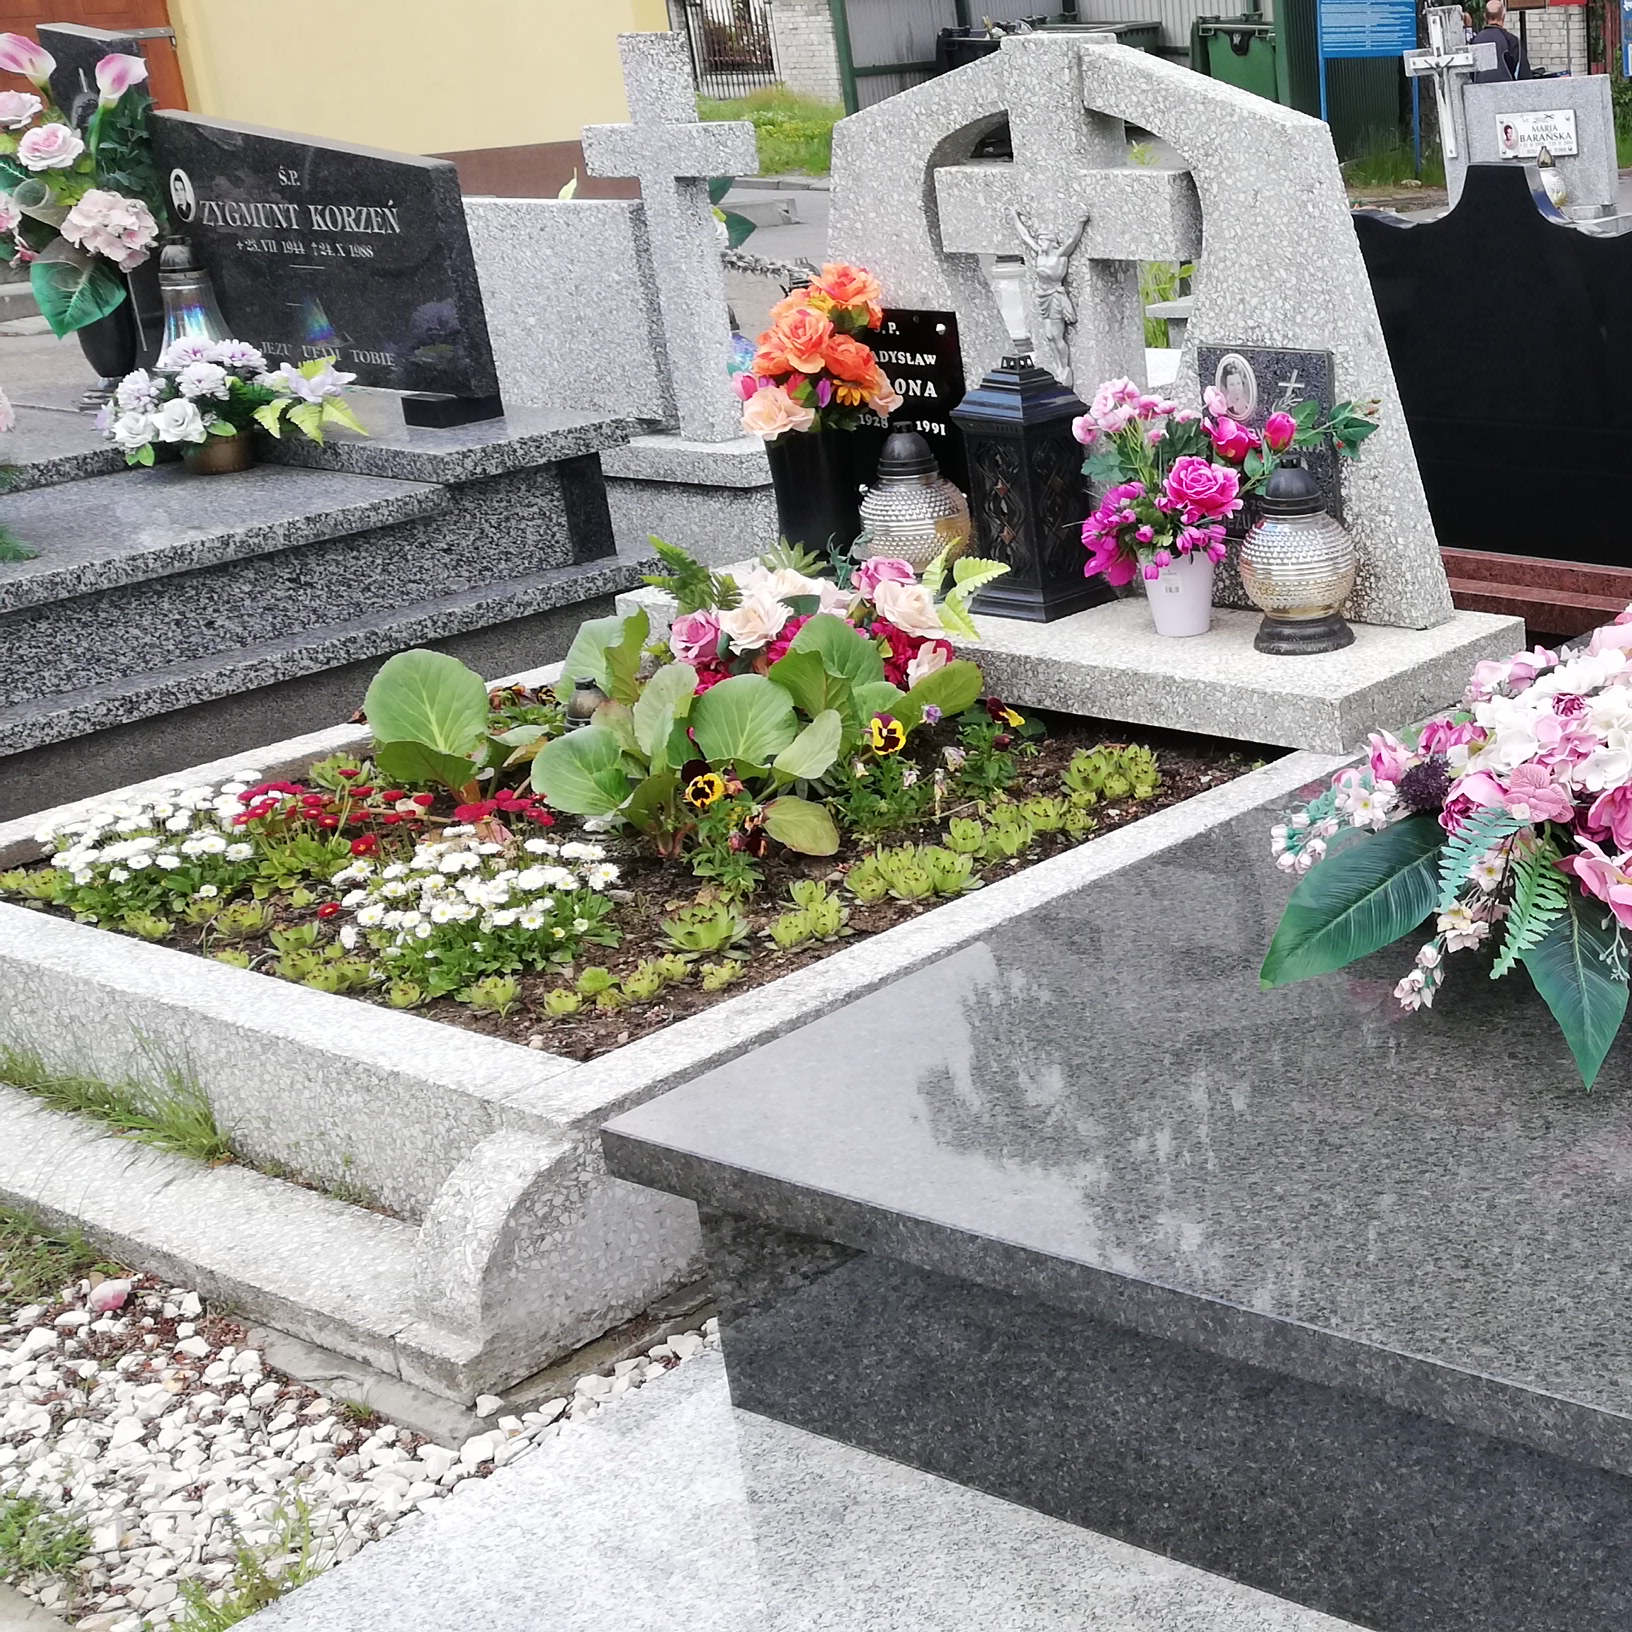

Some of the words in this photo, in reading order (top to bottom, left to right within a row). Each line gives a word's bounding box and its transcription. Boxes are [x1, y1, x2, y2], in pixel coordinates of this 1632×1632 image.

[1532, 124, 1558, 133] MARIA
[1520, 131, 1573, 143] BARAŃSKA
[200, 200, 300, 230] ZYGMUNT
[307, 199, 401, 234] KORZEŃ
[350, 350, 396, 366] TOBIE
